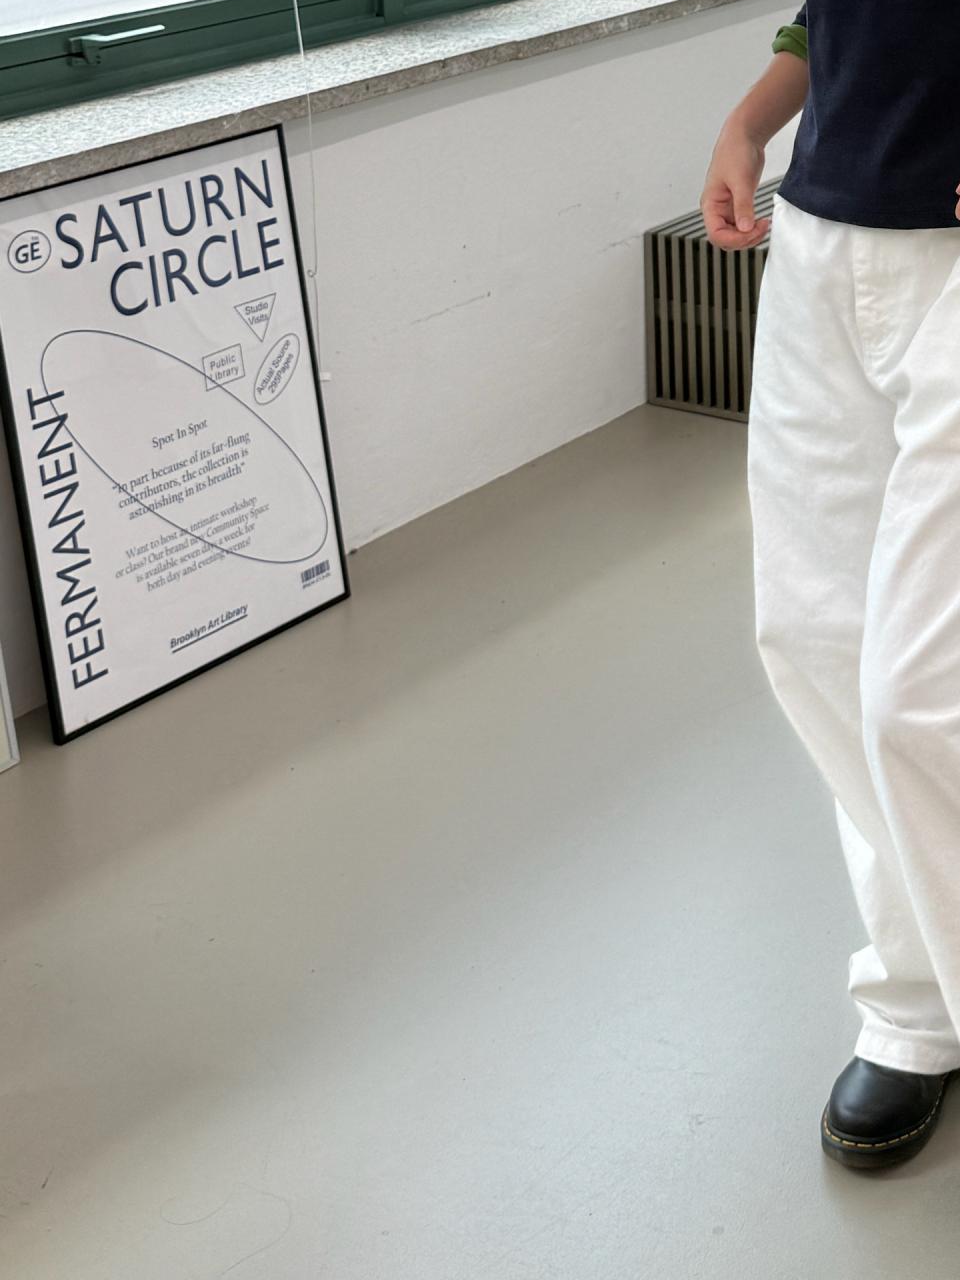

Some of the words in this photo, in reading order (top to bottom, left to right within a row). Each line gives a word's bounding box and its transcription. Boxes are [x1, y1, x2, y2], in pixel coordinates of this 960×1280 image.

[55, 159, 273, 269] SATURN
[15, 241, 42, 264] GE
[110, 217, 285, 316] CIRCLE
[245, 302, 269, 315] Studio
[248, 314, 270, 326] Visits
[210, 354, 237, 370] Public
[210, 366, 239, 381] Library
[256, 367, 275, 395] Actual
[272, 339, 291, 368] Source
[152, 433, 175, 450] Spot
[176, 428, 187, 439] In
[188, 419, 208, 436] Spot
[118, 478, 181, 509] contributors,
[181, 469, 197, 483] the
[198, 451, 240, 476] collection
[240, 446, 249, 458] is
[129, 474, 150, 492] part
[150, 458, 189, 480] because
[189, 450, 199, 465] of
[199, 448, 211, 461] its
[211, 432, 251, 455] far-flung
[128, 490, 185, 520] astonishing
[184, 486, 195, 497] in
[195, 480, 207, 493] its
[27, 388, 109, 690] FERMANENT
[115, 570, 124, 579] or
[125, 557, 148, 574] class?
[149, 551, 164, 564] Our
[164, 539, 190, 559] brand
[206, 514, 249, 537] Community
[250, 503, 270, 519] Space
[124, 545, 149, 560] Want
[150, 539, 160, 550] to
[160, 531, 178, 545] host
[190, 513, 220, 532] intimate
[220, 496, 258, 518] workshop
[136, 573, 144, 583] is
[144, 558, 179, 580] available
[179, 549, 201, 564] seven
[223, 526, 245, 543] week
[244, 522, 256, 533] for
[145, 575, 166, 592] both
[166, 570, 181, 584] day
[182, 562, 198, 576] and
[197, 551, 226, 569] evening
[170, 625, 207, 649] Brooklyn
[207, 618, 220, 631] Art
[221, 604, 248, 623] Library
